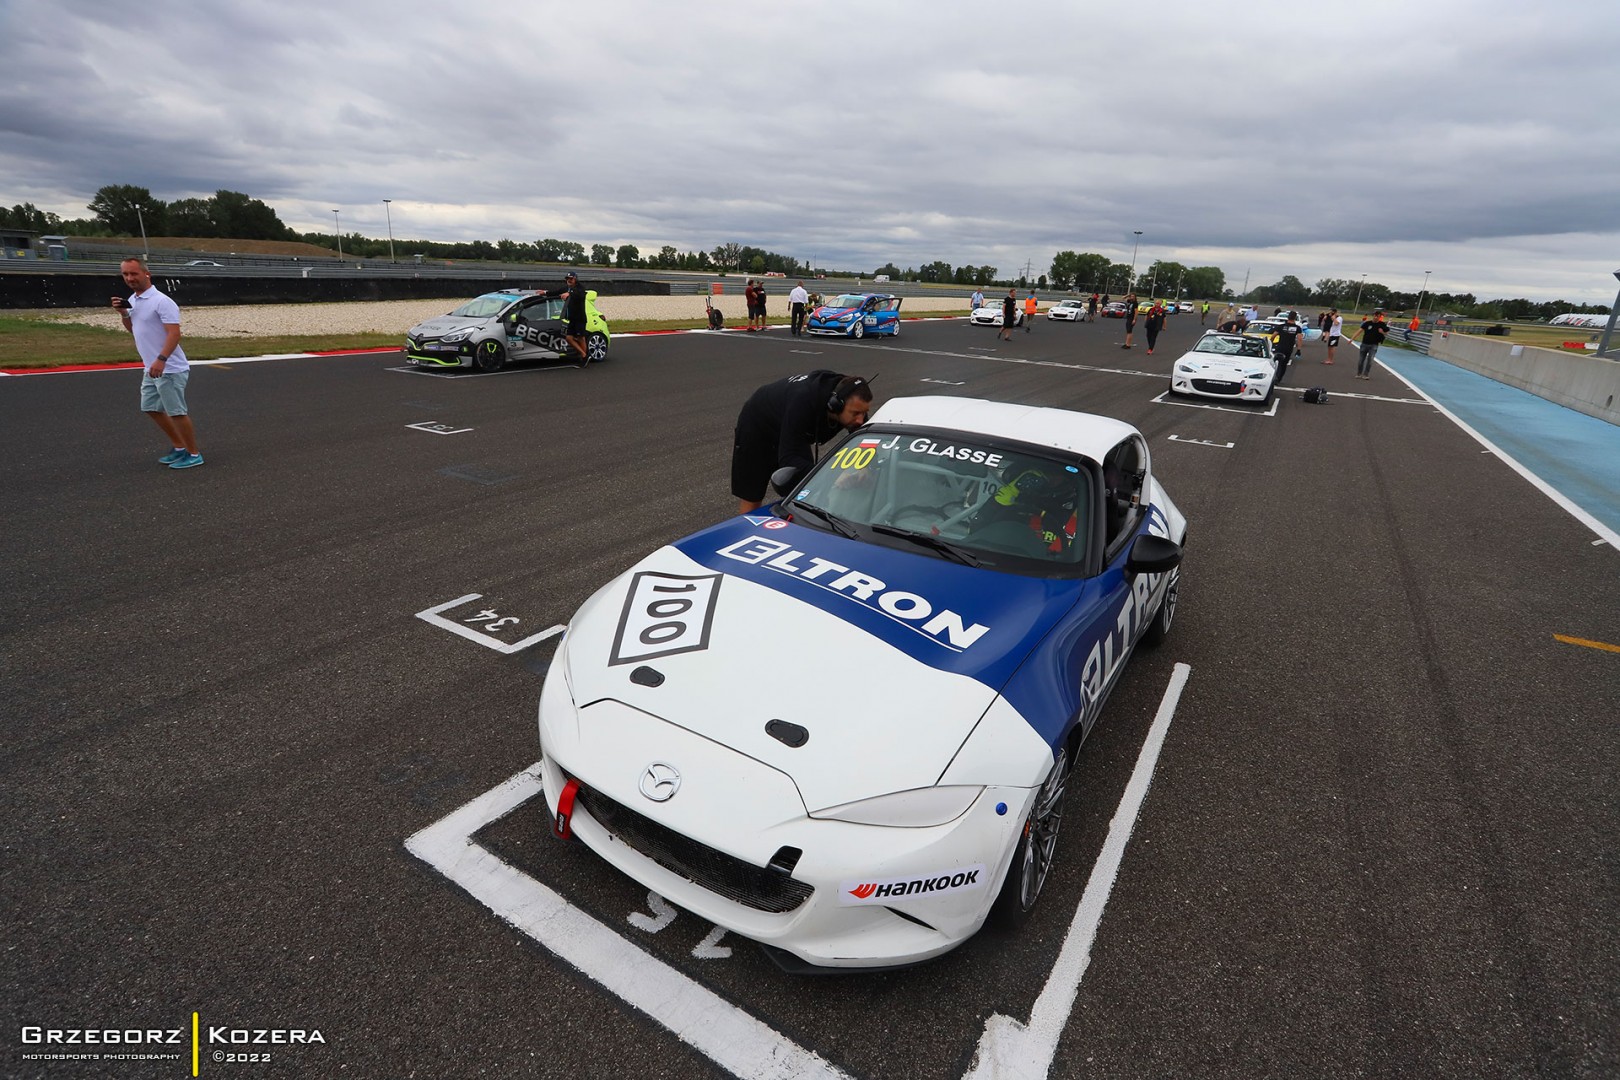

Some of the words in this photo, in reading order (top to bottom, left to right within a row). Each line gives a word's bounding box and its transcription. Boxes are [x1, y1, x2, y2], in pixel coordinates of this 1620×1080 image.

[831, 447, 876, 470] 100
[881, 435, 901, 451] J.
[909, 438, 1003, 468] GLASSE
[715, 535, 991, 650] ELTRON
[464, 608, 520, 631] 34
[639, 584, 697, 645] 100
